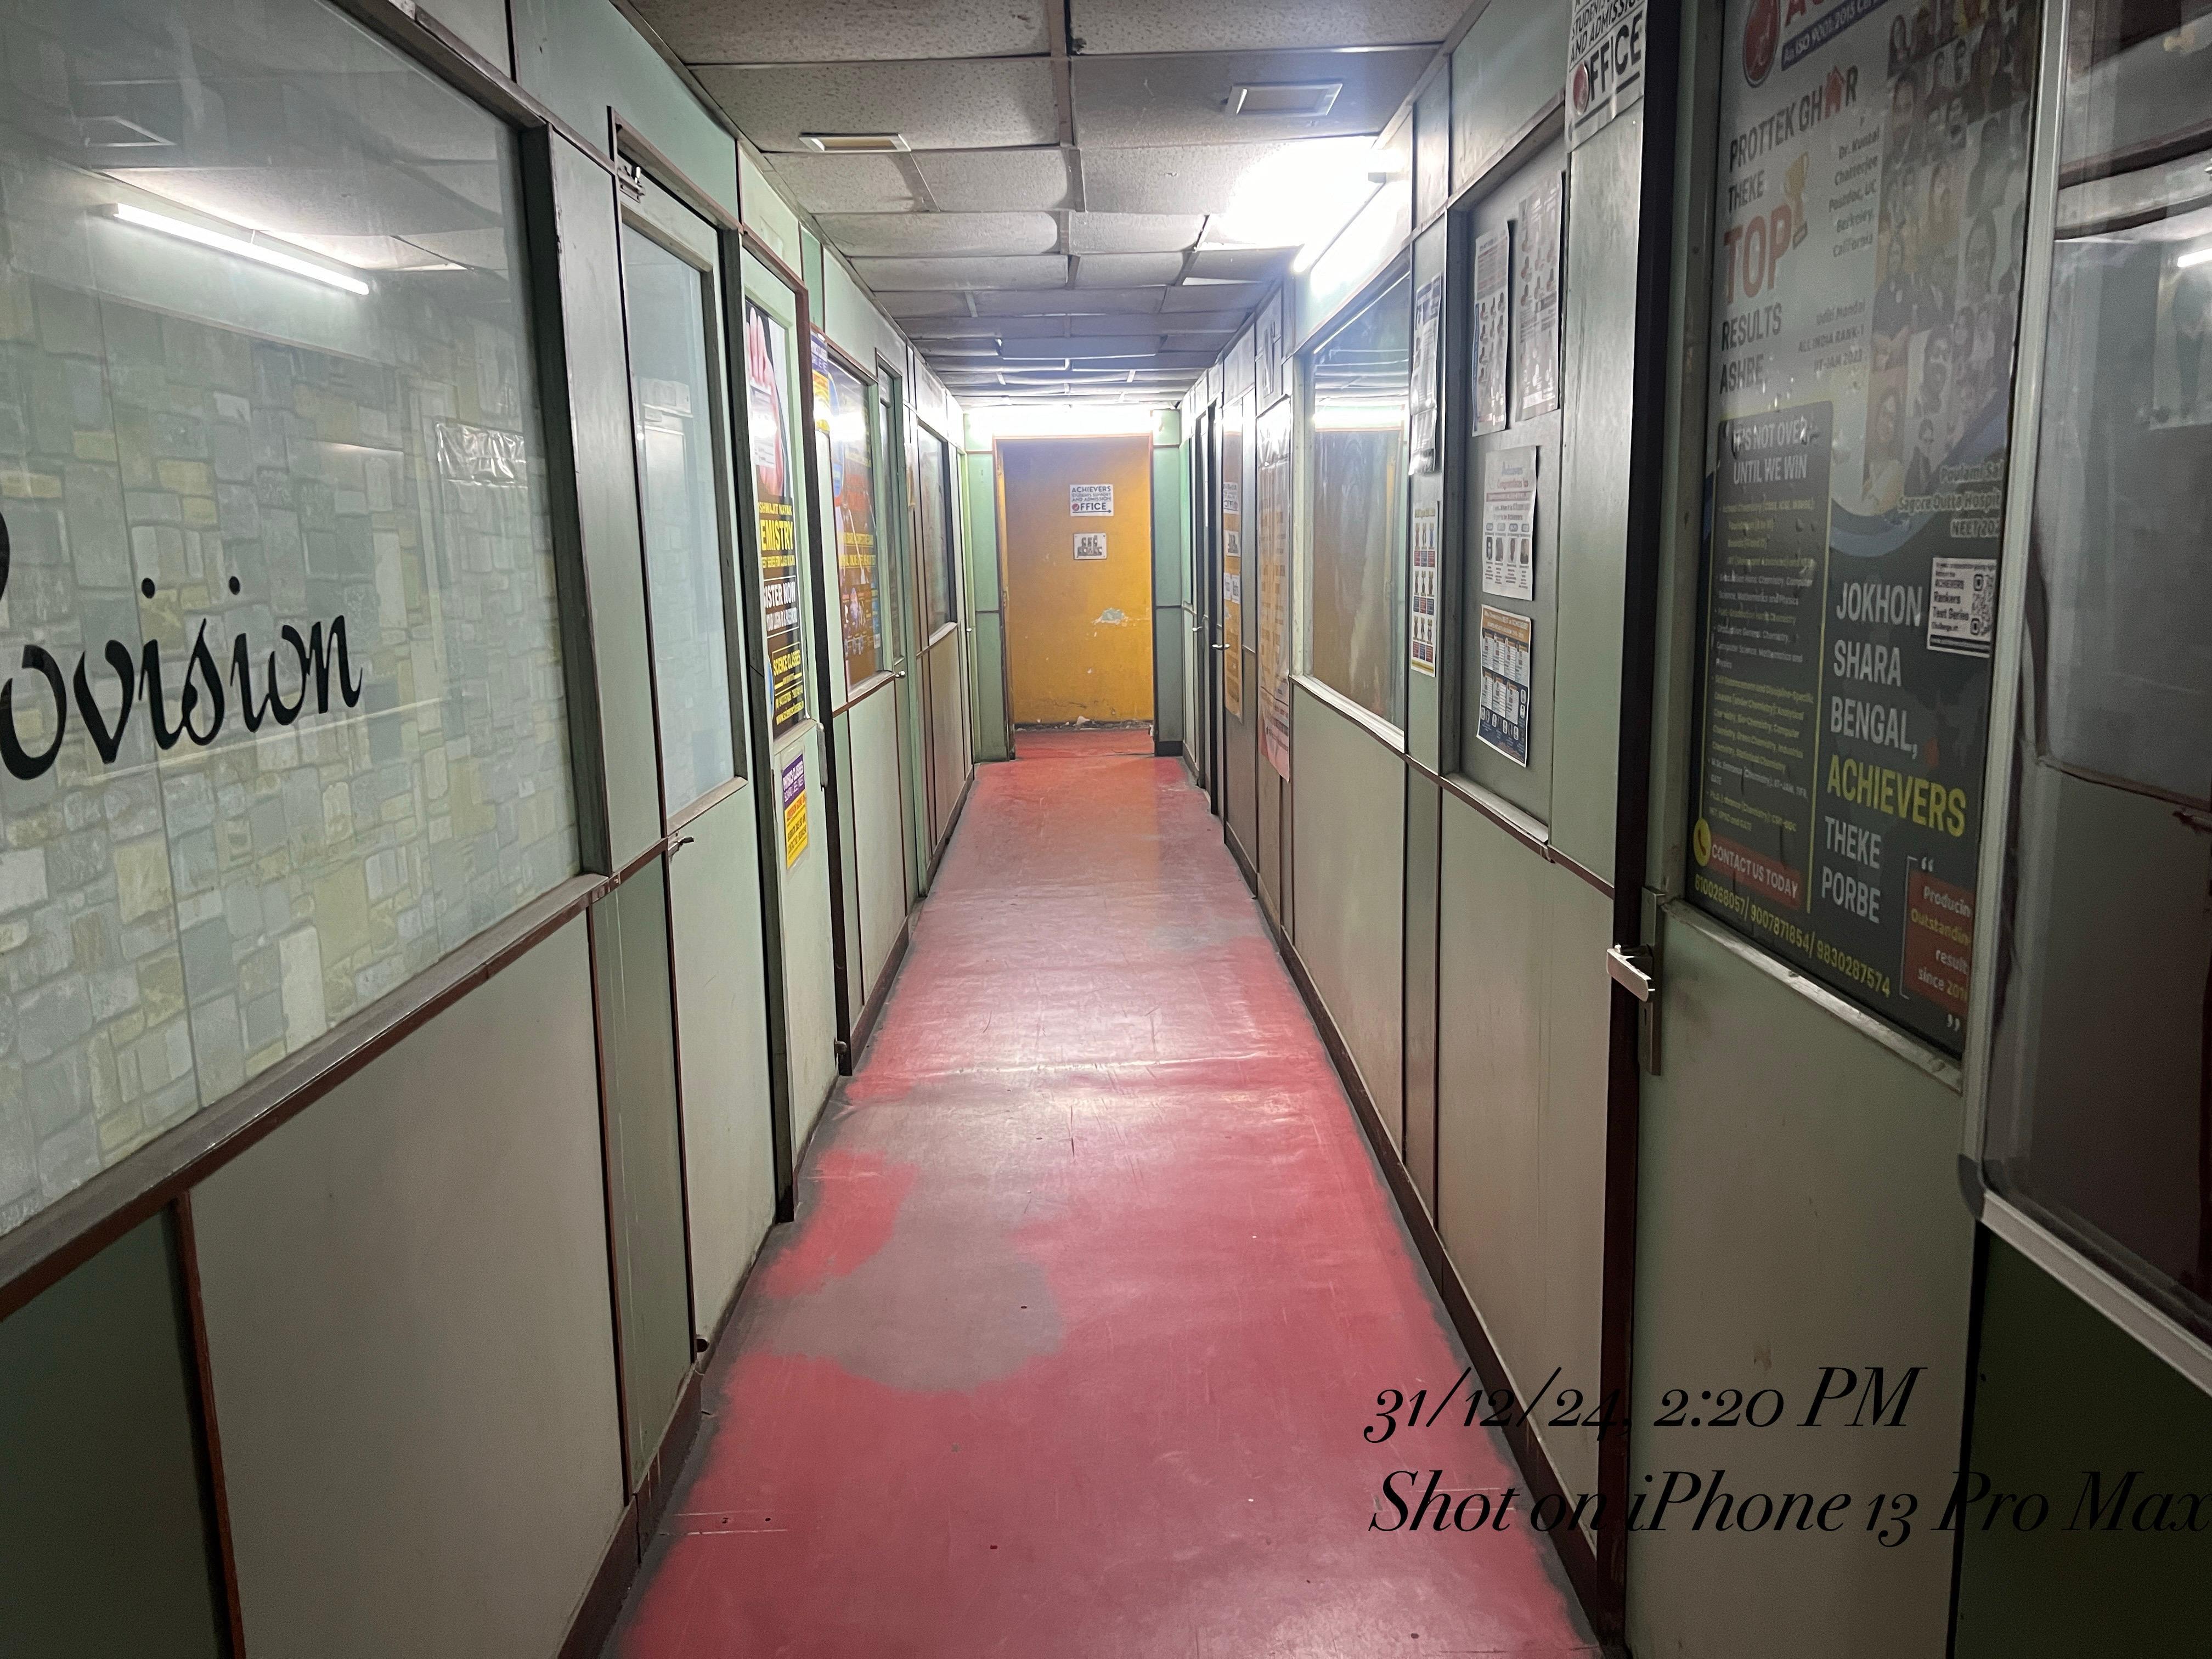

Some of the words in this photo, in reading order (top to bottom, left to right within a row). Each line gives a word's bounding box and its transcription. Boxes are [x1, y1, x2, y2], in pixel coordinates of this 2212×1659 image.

[1571, 31, 1588, 66] AND
[1729, 102, 1795, 173] PROTTEK
[1728, 169, 1764, 215] THEKE
[1724, 204, 1792, 304] TOP
[1721, 302, 1781, 352] RESULTS
[1753, 423, 1775, 449] NOT
[1733, 459, 1763, 485] UNTIL
[1764, 456, 1782, 482] WE
[1784, 453, 1807, 481] WIN
[760, 520, 793, 551] EMISTRY
[783, 582, 795, 604] NOW
[1836, 582, 1923, 628] JOKHON
[0, 576, 363, 781] ovision
[1832, 639, 1904, 687] SHARA
[1830, 696, 1920, 760] BENGAL,
[1827, 755, 1966, 837] ACHIEVERS
[1823, 815, 1882, 871] THEKE
[1711, 842, 1751, 876] CONTACT
[1752, 861, 1764, 883] US
[1765, 867, 1798, 900] TODAY
[1821, 865, 1882, 926] PORBE
[1922, 883, 1973, 919] Producin
[1910, 906, 1972, 949] Outstandin
[1917, 963, 1944, 991] since
[1946, 979, 1967, 1003] 201
[1936, 945, 1969, 975] result
